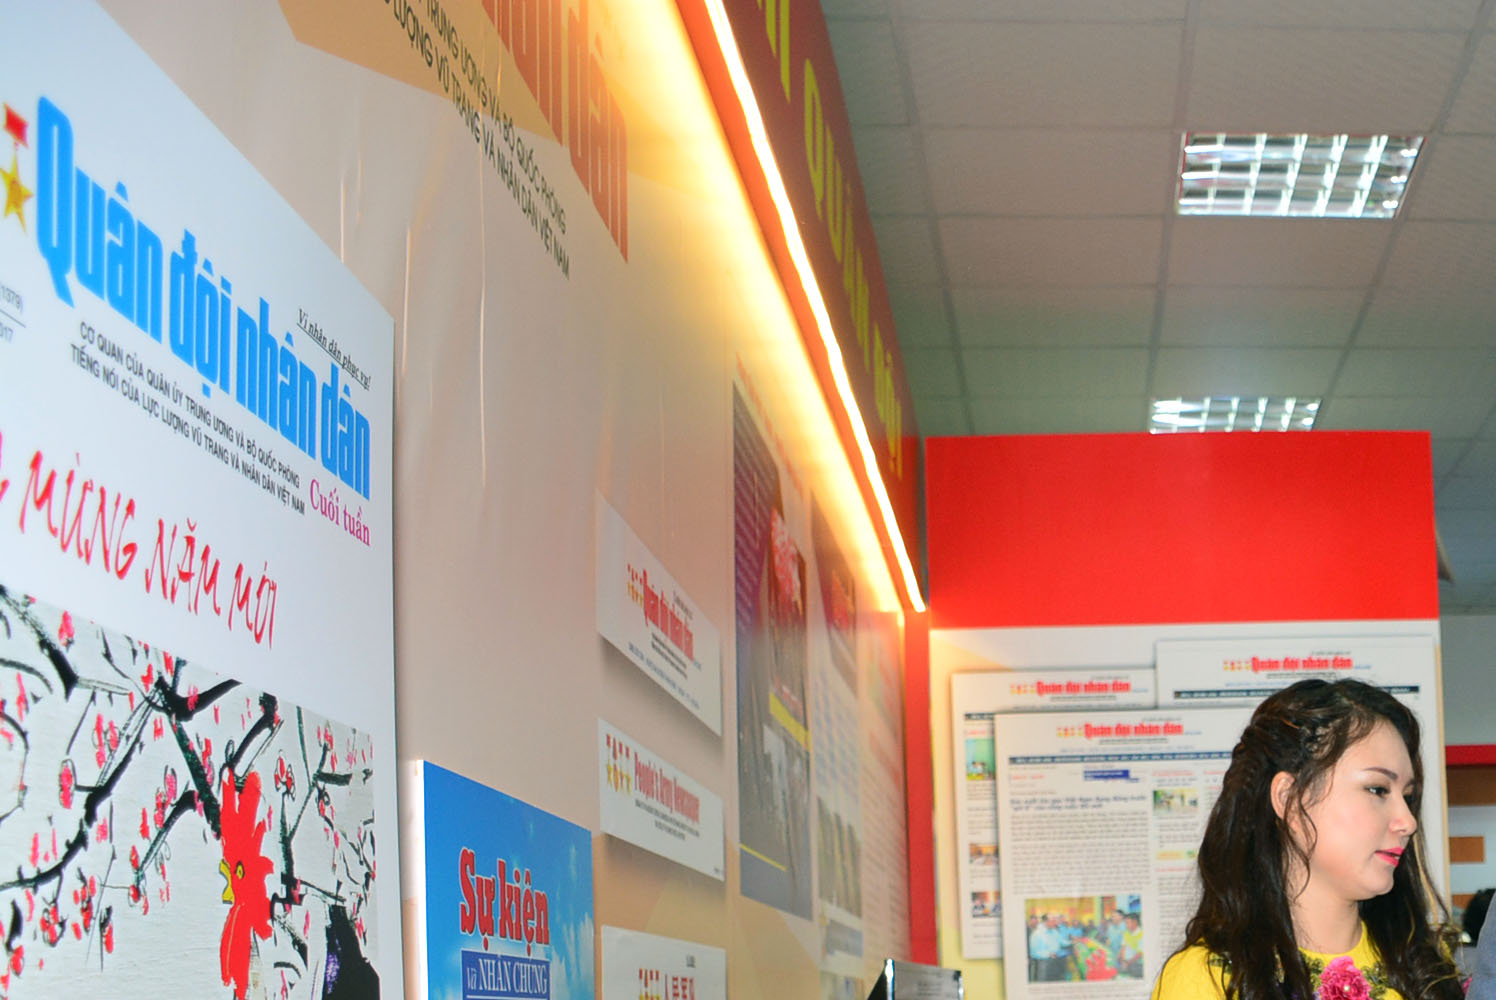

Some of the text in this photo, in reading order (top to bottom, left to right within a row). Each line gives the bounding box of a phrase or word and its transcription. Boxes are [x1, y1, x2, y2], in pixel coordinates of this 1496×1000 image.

[435, 46, 450, 94] VŨ
[452, 72, 481, 143] TRANG
[482, 122, 496, 169] VÀ
[497, 147, 520, 206] NHÂN
[521, 185, 538, 233] DÂN
[553, 235, 569, 280] NAM
[461, 39, 488, 107] ƯƠNG
[489, 88, 502, 133] VÀ
[503, 112, 515, 155] BỘ
[516, 136, 540, 193] QUỐC
[36, 96, 371, 501] Quân đội nhân dân
[308, 323, 328, 348] nhân
[328, 339, 342, 360] dân
[70, 343, 305, 515] TIẾNG NÓI CỦA LỰC LƯỢNG VŨ TRANG VÀ NHÂN DÂN VIỆT NAM
[80, 321, 300, 488] CƠ QUAN CỦA QUÂN ỦY TRUNG ƯƠNG VÀ BỘ QUỐC PHÒNG
[19, 450, 138, 580] MỪNG
[144, 517, 221, 617] NĂM
[228, 561, 277, 650] MỚI
[309, 478, 371, 547] Cuối tuần
[459, 847, 551, 957] Sự kiện
[478, 955, 511, 993] NHÂN
